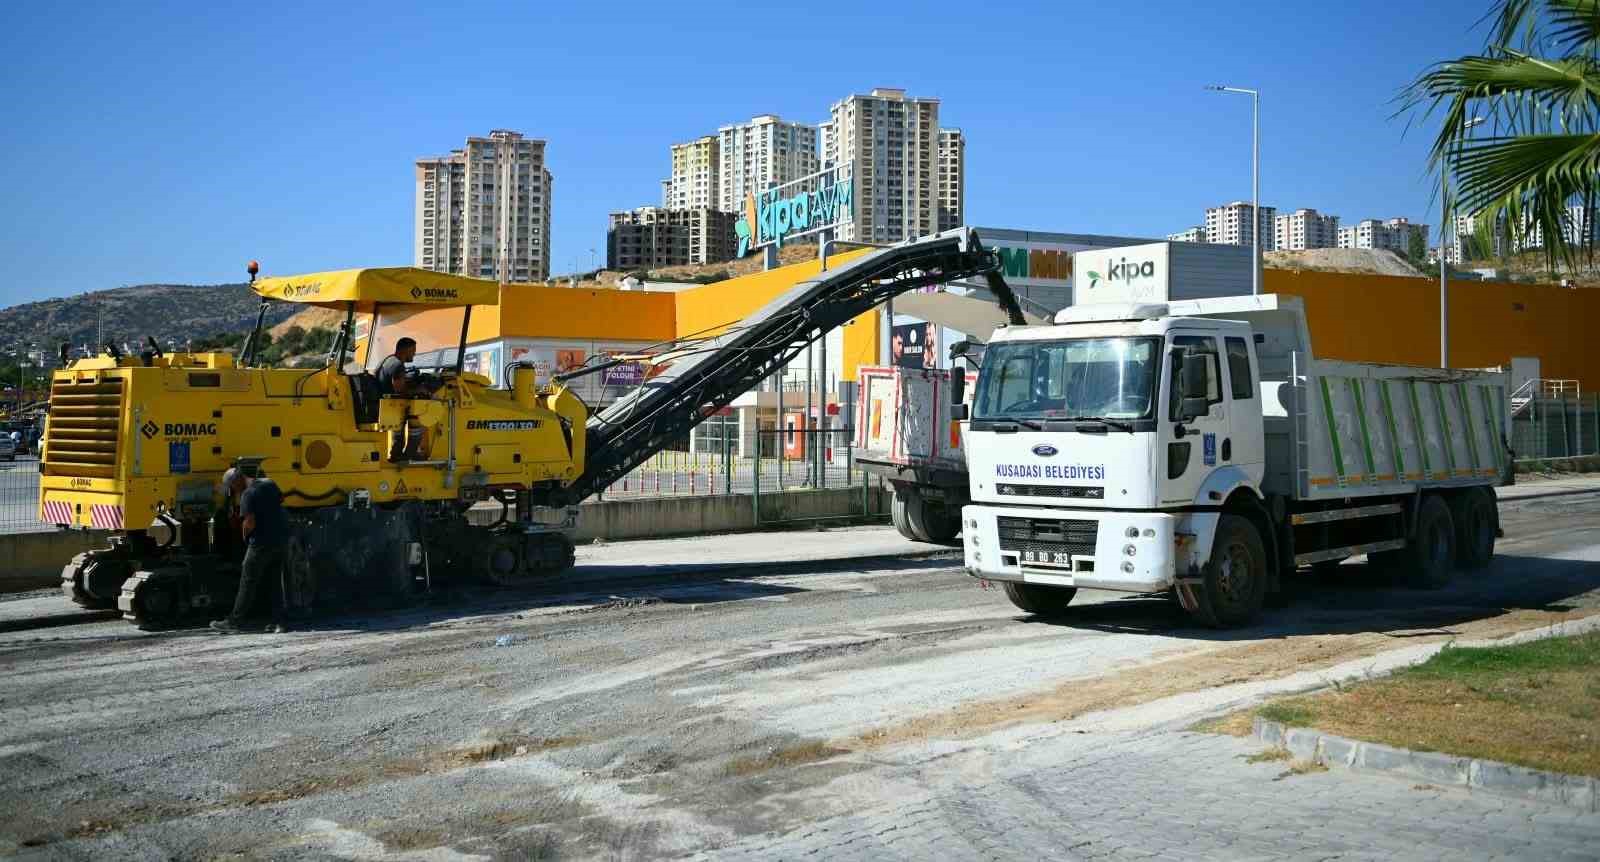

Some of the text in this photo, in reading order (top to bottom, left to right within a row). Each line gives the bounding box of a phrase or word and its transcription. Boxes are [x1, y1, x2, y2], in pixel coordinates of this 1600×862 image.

[756, 177, 853, 249] kipa AVM
[1107, 256, 1155, 286] kipa
[424, 288, 458, 299] BOMAG
[164, 423, 217, 436] BOMAG
[1045, 464, 1105, 479] BELEDİYESİ
